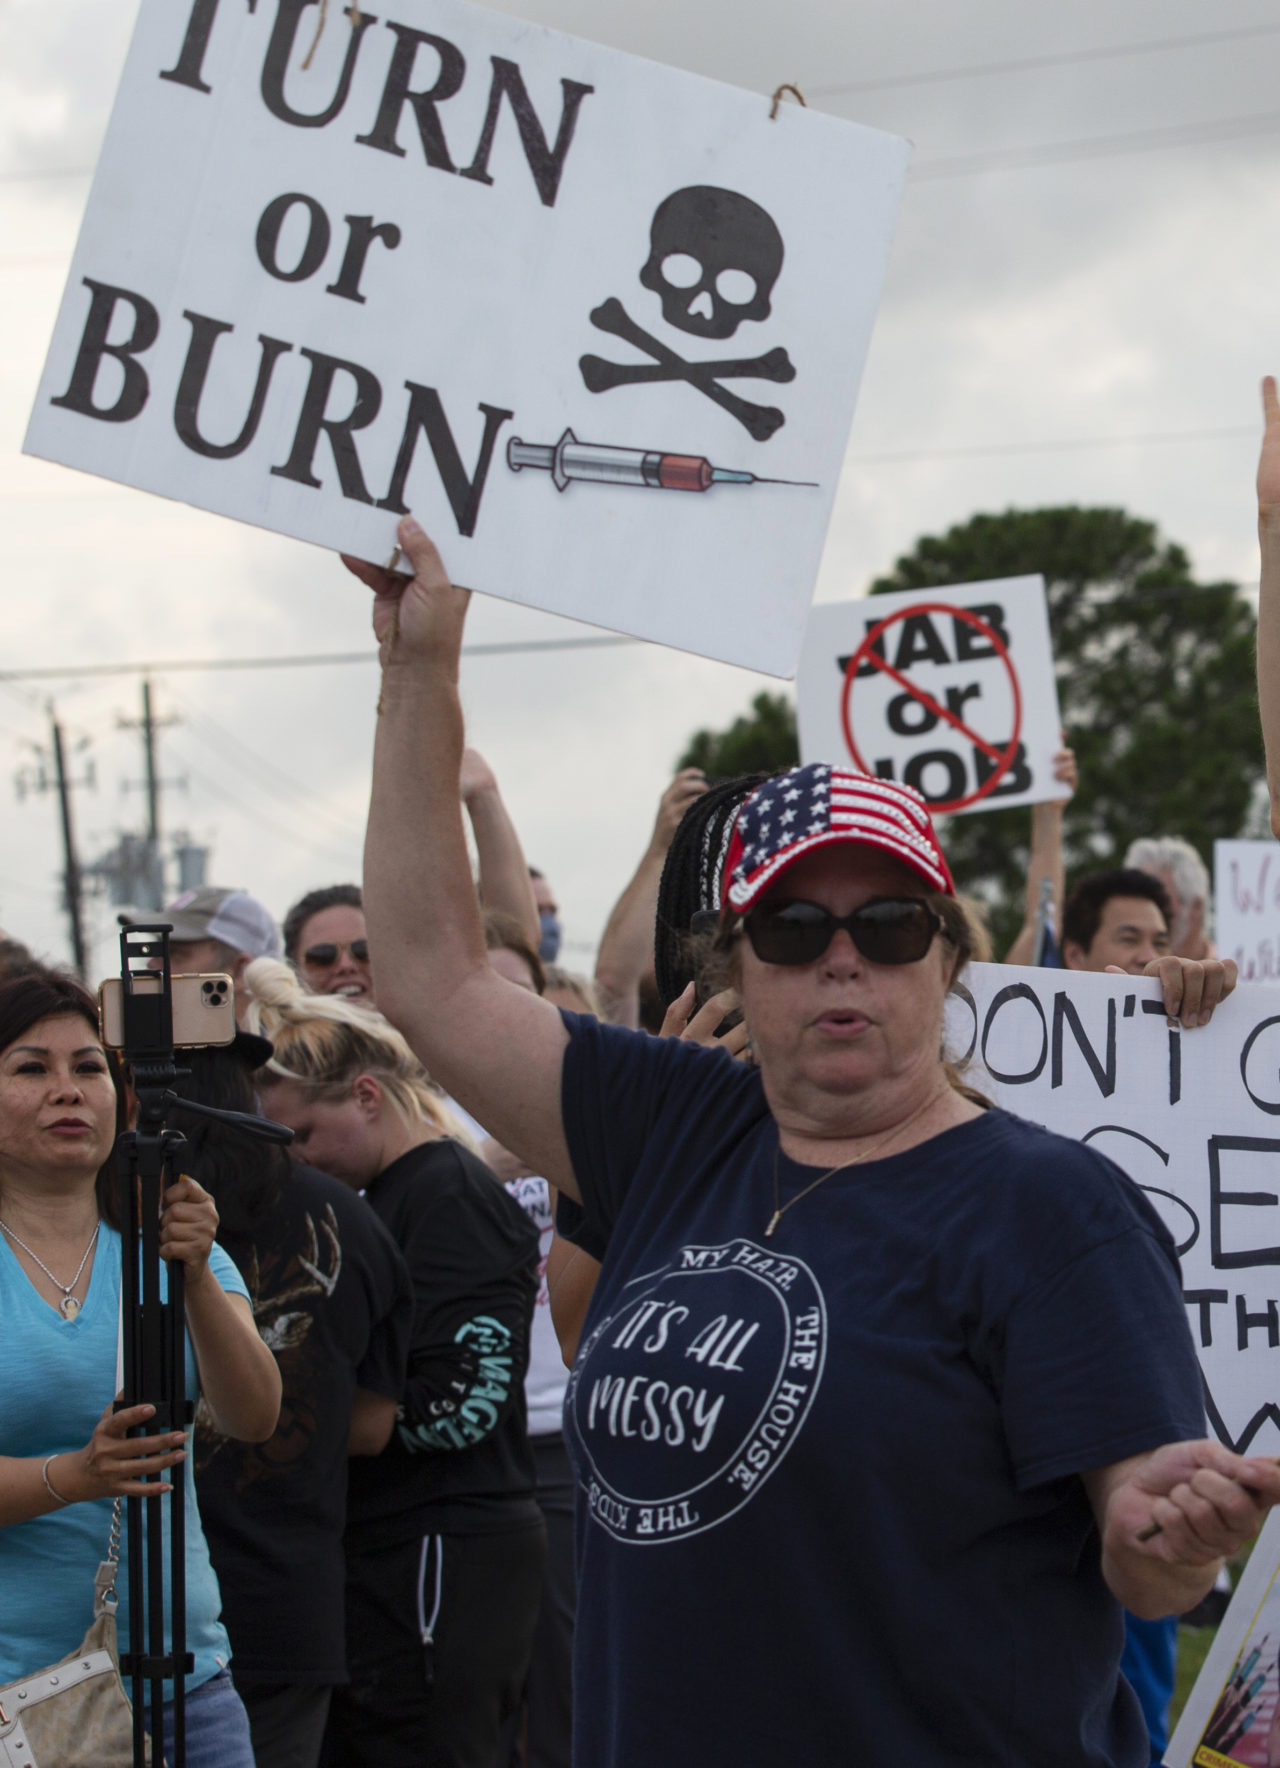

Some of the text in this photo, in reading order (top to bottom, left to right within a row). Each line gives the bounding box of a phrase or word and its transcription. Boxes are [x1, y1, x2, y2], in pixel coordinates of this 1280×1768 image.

[159, 0, 595, 208] TURN
[255, 192, 401, 304] or
[49, 276, 514, 539] BURN
[836, 603, 1011, 679] JAB
[886, 682, 981, 736] or
[680, 1249, 730, 1269] MY
[612, 1300, 760, 1372] IT'S ALL
[789, 1306, 820, 1371] THE
[588, 1374, 725, 1452] MESSY
[636, 1501, 700, 1534] THE
